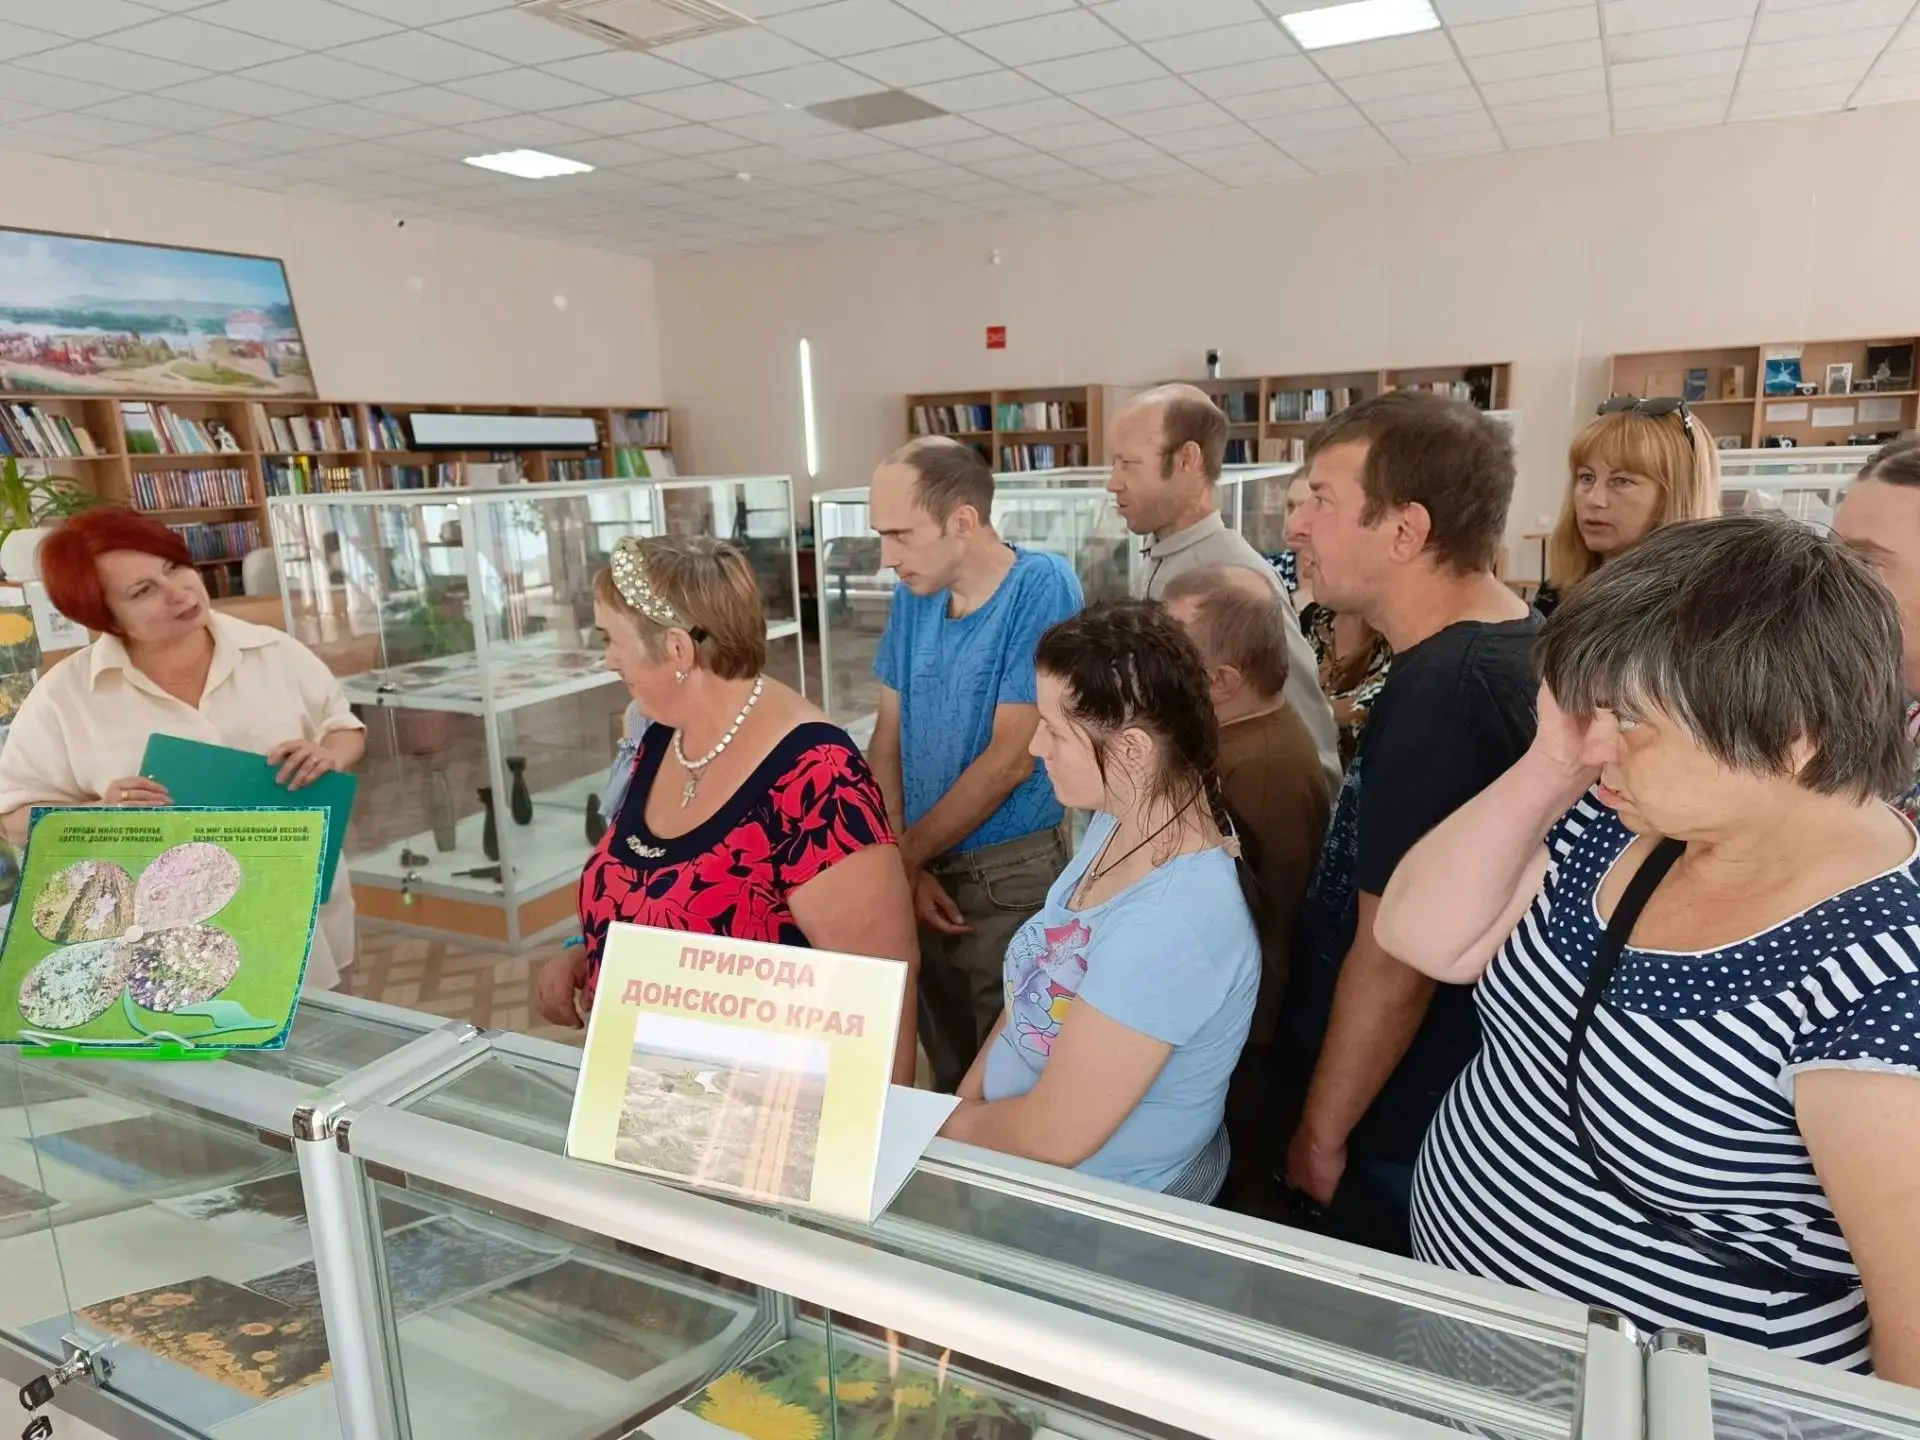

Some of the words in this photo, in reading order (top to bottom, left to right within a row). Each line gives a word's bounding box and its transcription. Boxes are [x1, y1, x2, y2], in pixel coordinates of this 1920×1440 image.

[678, 946, 816, 988] ПРИРОДА
[621, 979, 777, 1024] ДОНСКОГО
[786, 1002, 866, 1039] КРАЯ
